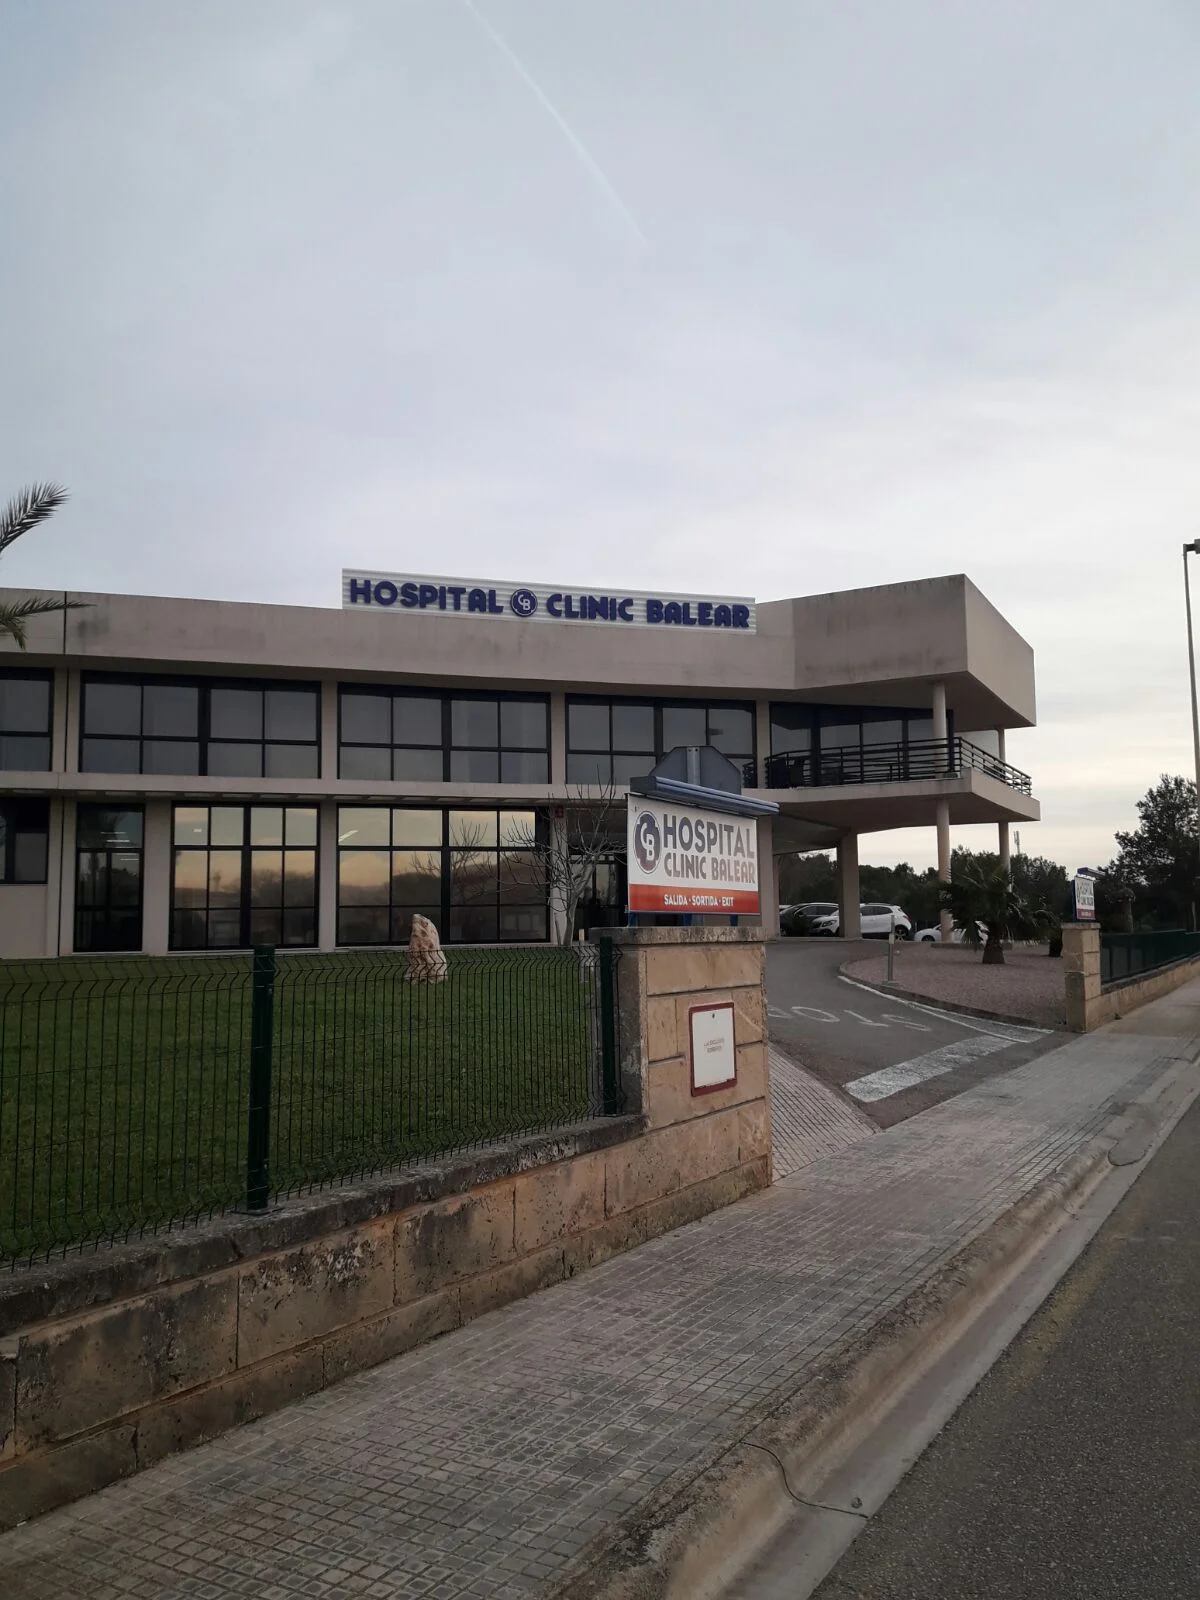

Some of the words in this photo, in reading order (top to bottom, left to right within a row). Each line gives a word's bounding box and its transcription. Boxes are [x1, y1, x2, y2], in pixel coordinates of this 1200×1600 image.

[349, 578, 504, 614] HOSPITAL
[546, 593, 634, 622] CLINIC
[645, 599, 750, 628] BALEAR
[663, 813, 755, 859] HOSPITAL
[664, 852, 707, 880] CLINIC
[711, 857, 756, 884] BALEAR
[664, 894, 688, 906] SALIDA
[691, 895, 719, 907] SORTIDA
[721, 896, 734, 907] EXIT
